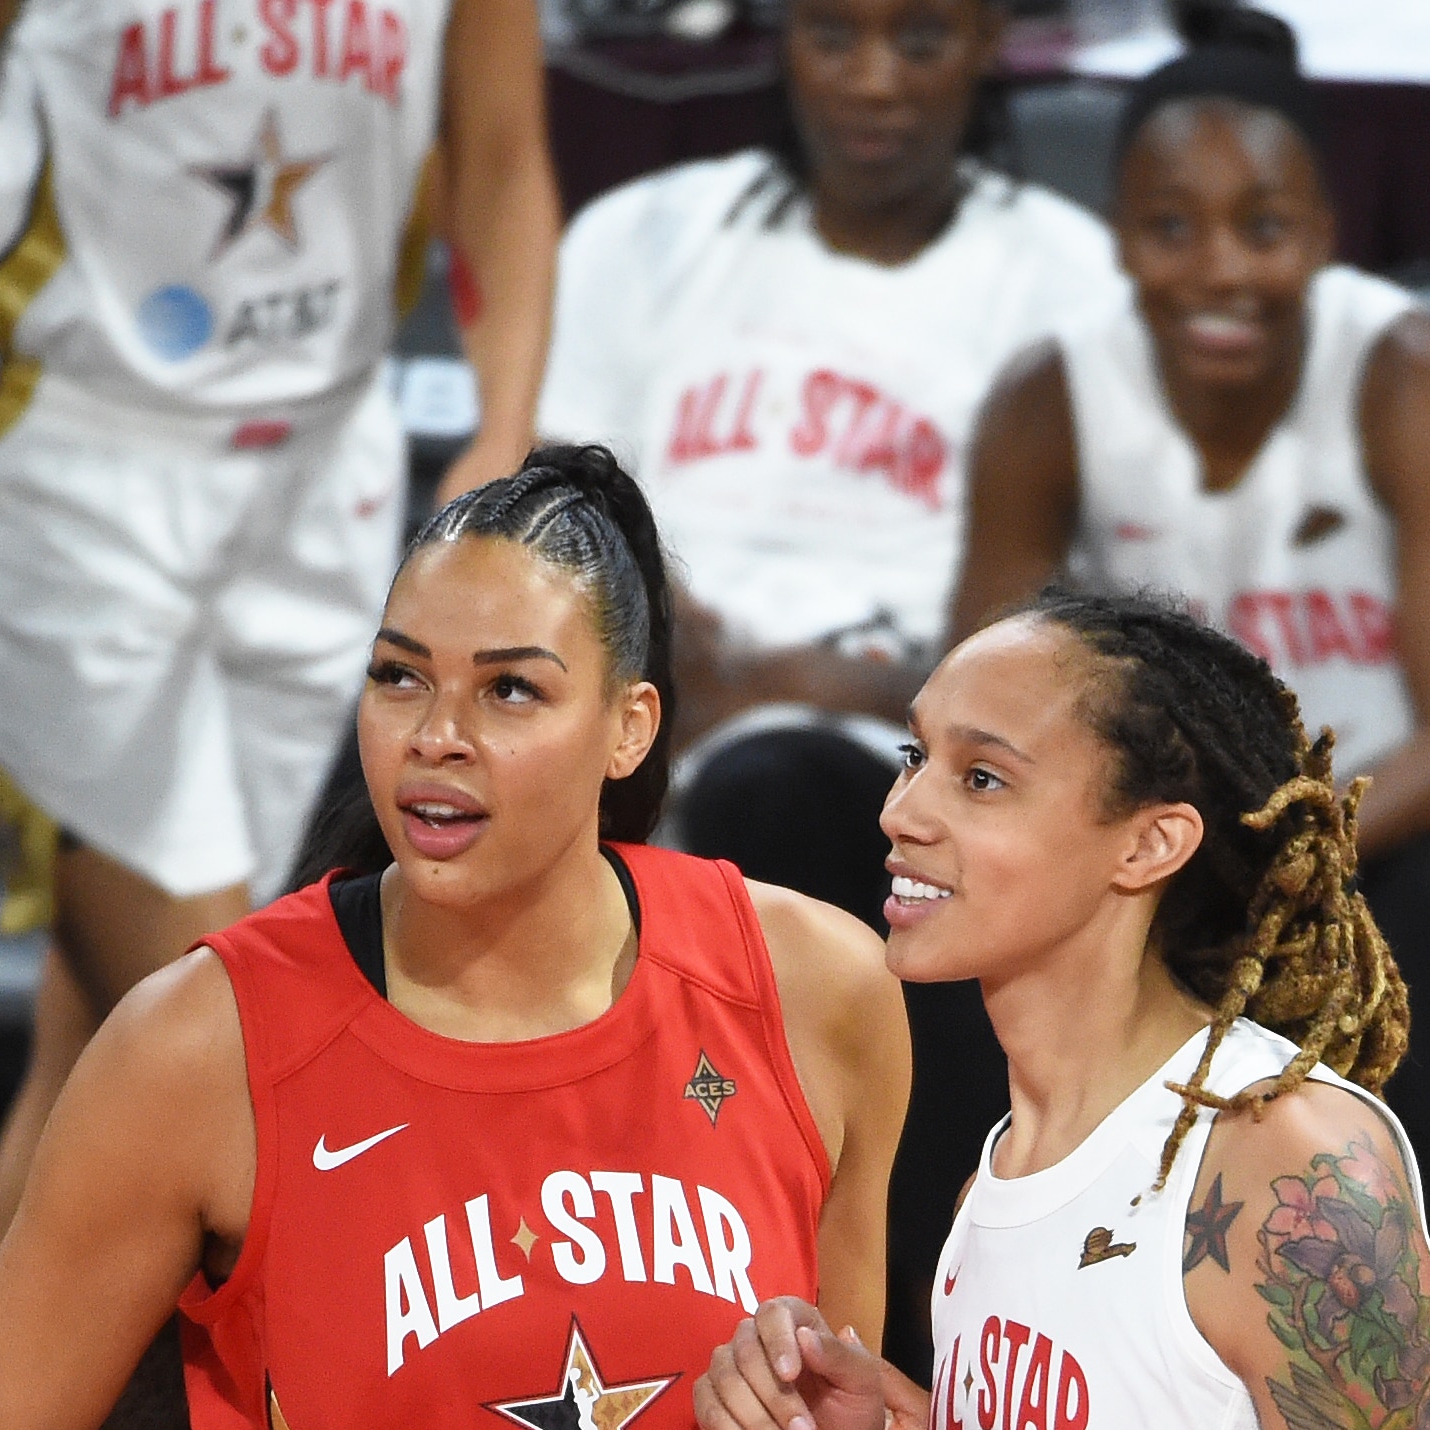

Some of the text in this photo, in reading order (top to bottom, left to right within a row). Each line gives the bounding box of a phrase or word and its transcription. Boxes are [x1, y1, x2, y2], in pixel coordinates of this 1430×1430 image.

[790, 366, 949, 512] STAR
[684, 1080, 736, 1098] ACES
[383, 1170, 759, 1377] ALL STAR
